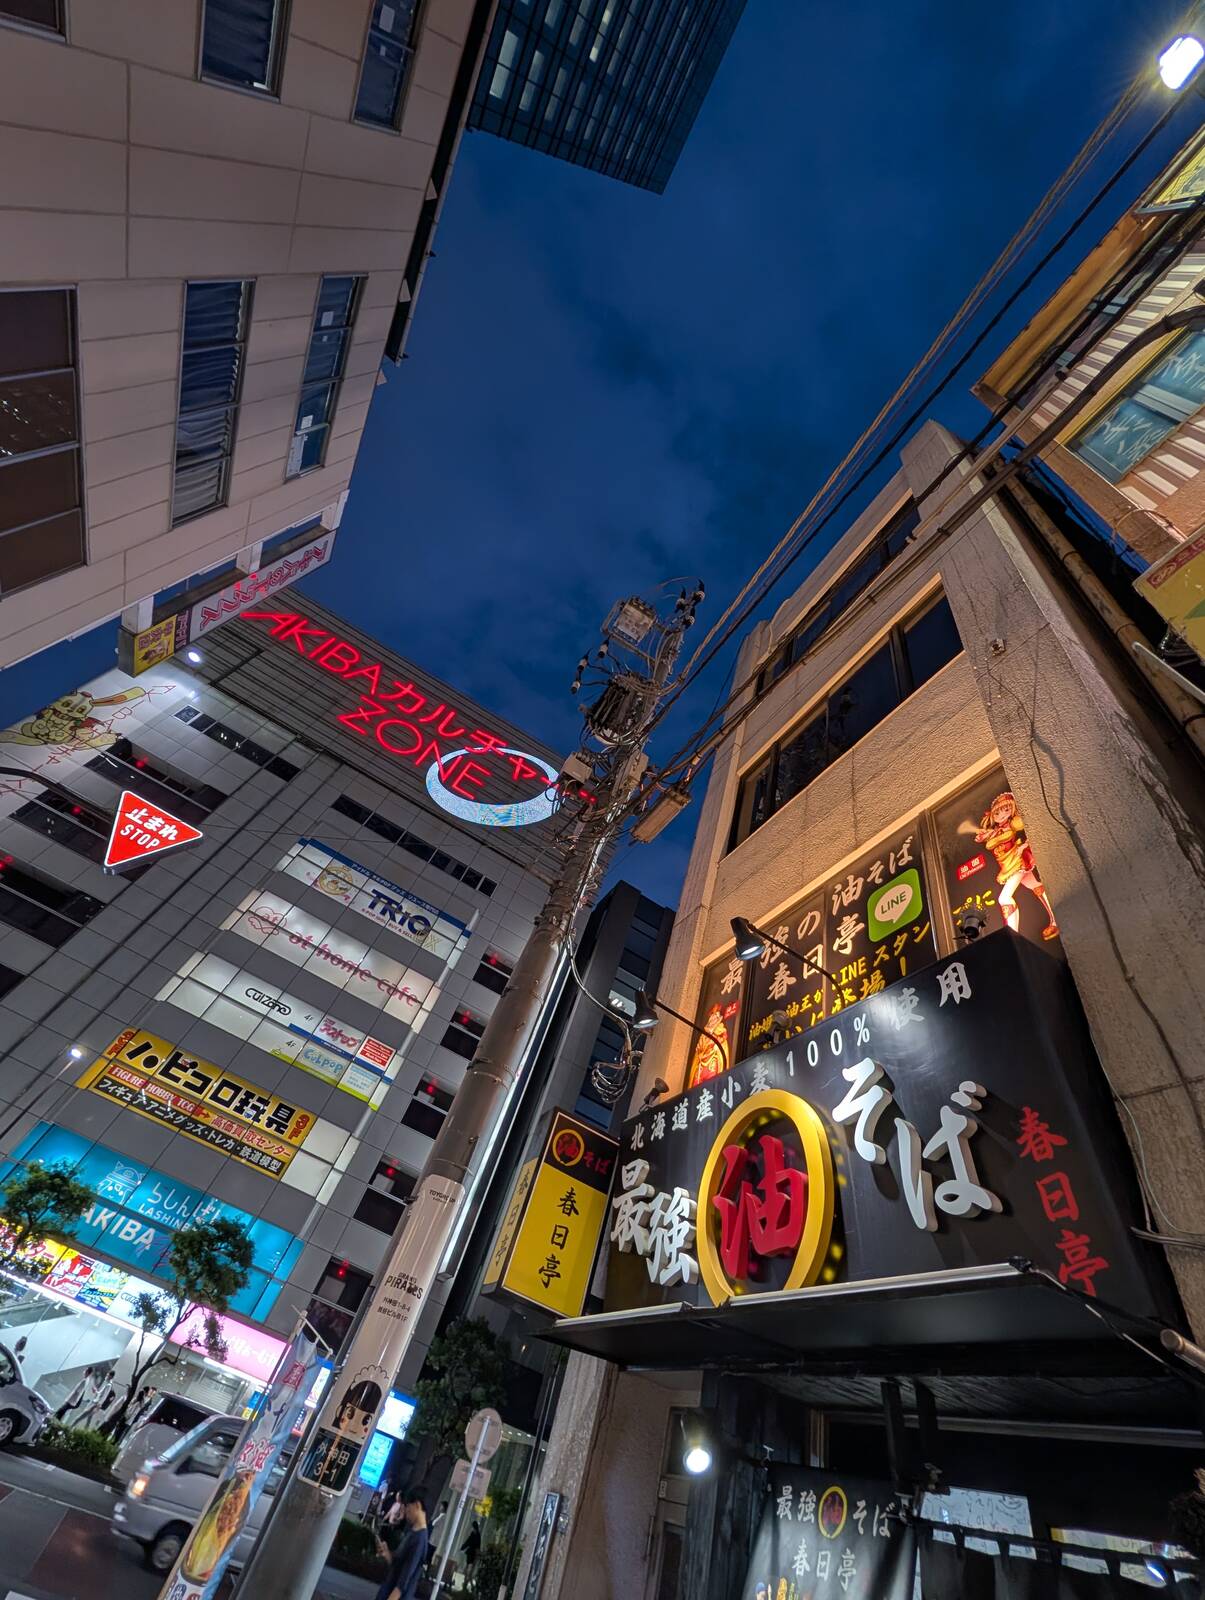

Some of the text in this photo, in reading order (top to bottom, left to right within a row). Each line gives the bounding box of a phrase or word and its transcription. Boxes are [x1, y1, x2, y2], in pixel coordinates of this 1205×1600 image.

[337, 695, 491, 800] ZONE
[120, 823, 160, 849] STOP
[125, 808, 178, 841] 止まれ
[366, 888, 432, 935] TRIO
[720, 836, 914, 996] 最強の油そば
[879, 890, 907, 915] LINE
[767, 912, 866, 1000] 春日亭
[111, 1066, 195, 1113] FIGURE HOBBY TCG
[211, 1115, 291, 1158] 高価買取センター
[1016, 1104, 1110, 1297] 春日亭
[538, 1187, 580, 1289] 春日亭
[384, 1274, 423, 1299] PIRATES
[313, 1462, 338, 1483] 3-1
[316, 1443, 351, 1466] 外神田
[791, 1538, 857, 1591] 春日亭
